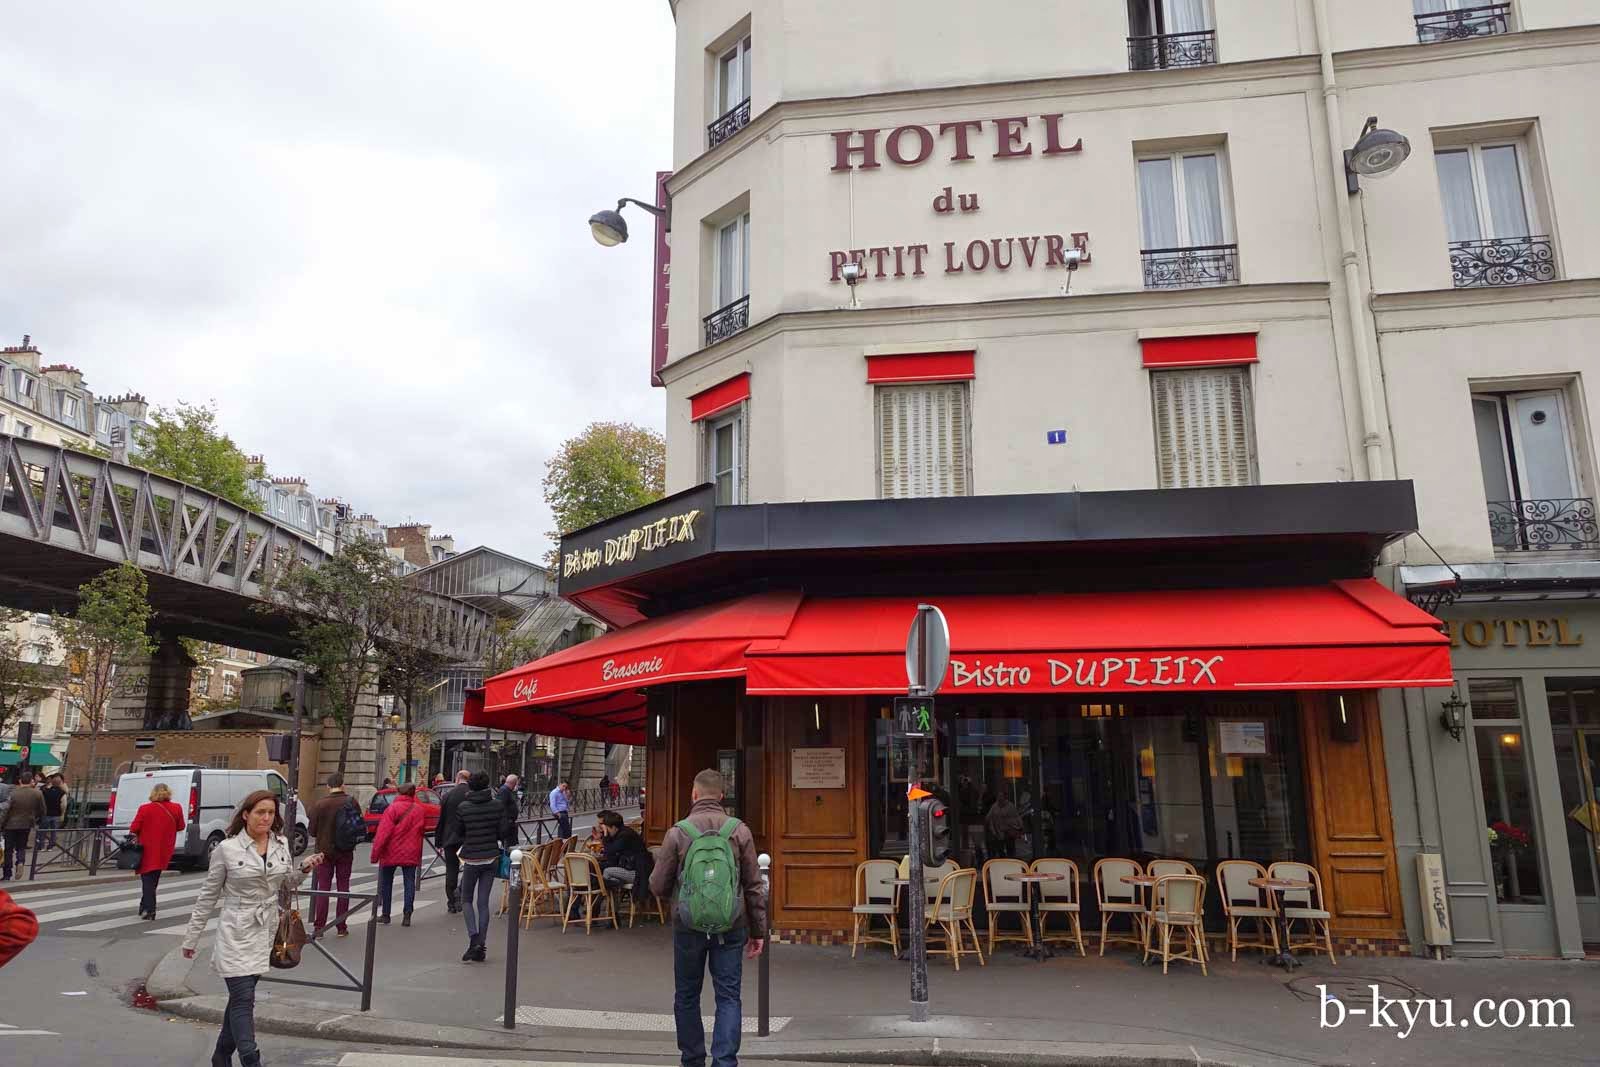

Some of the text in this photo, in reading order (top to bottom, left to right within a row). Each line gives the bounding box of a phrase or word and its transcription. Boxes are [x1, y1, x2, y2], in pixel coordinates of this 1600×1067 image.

[830, 113, 1083, 172] HOTEL
[932, 187, 980, 214] du
[829, 232, 1092, 282] PETIT LOUVRE
[563, 547, 602, 578] Bistro
[513, 656, 663, 701] Café Brasserie
[950, 656, 1224, 687] Bistro DUPLEIX
